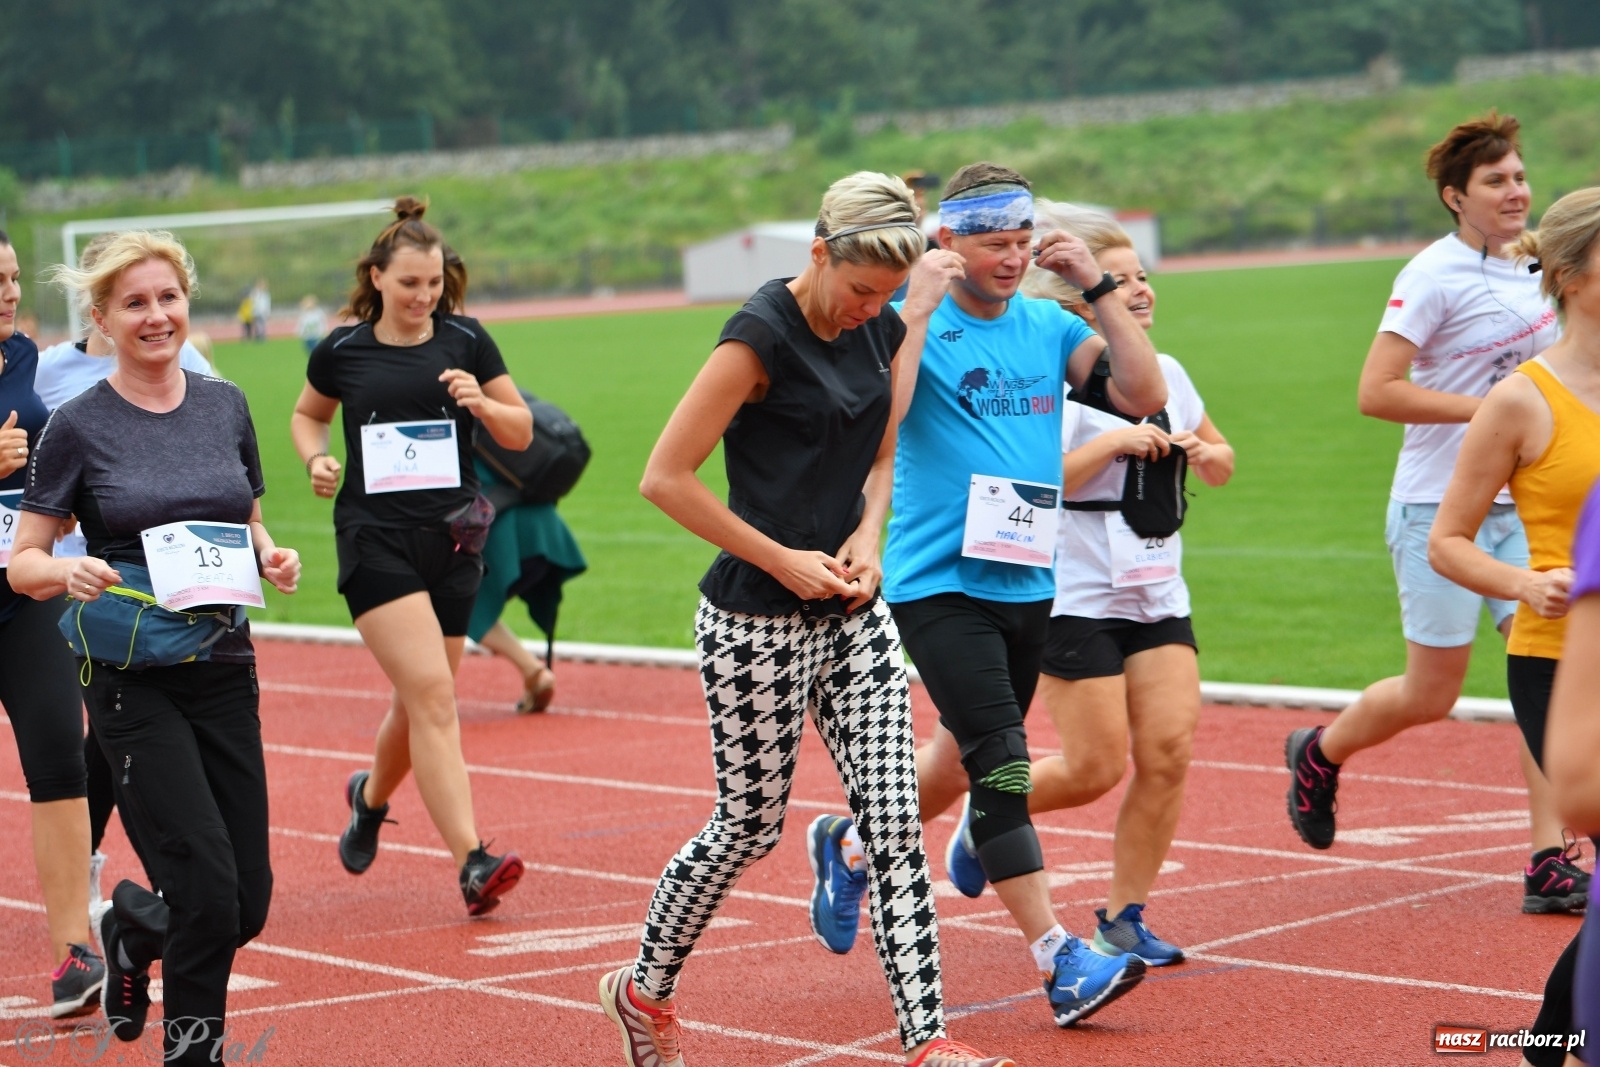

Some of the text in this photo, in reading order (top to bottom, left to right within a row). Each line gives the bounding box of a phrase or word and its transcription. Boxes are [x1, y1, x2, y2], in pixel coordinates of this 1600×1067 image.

[976, 398, 1030, 417] WORLD
[405, 443, 416, 460] 6
[3, 514, 13, 533] 9
[1008, 506, 1034, 528] 44
[194, 546, 223, 567] 13
